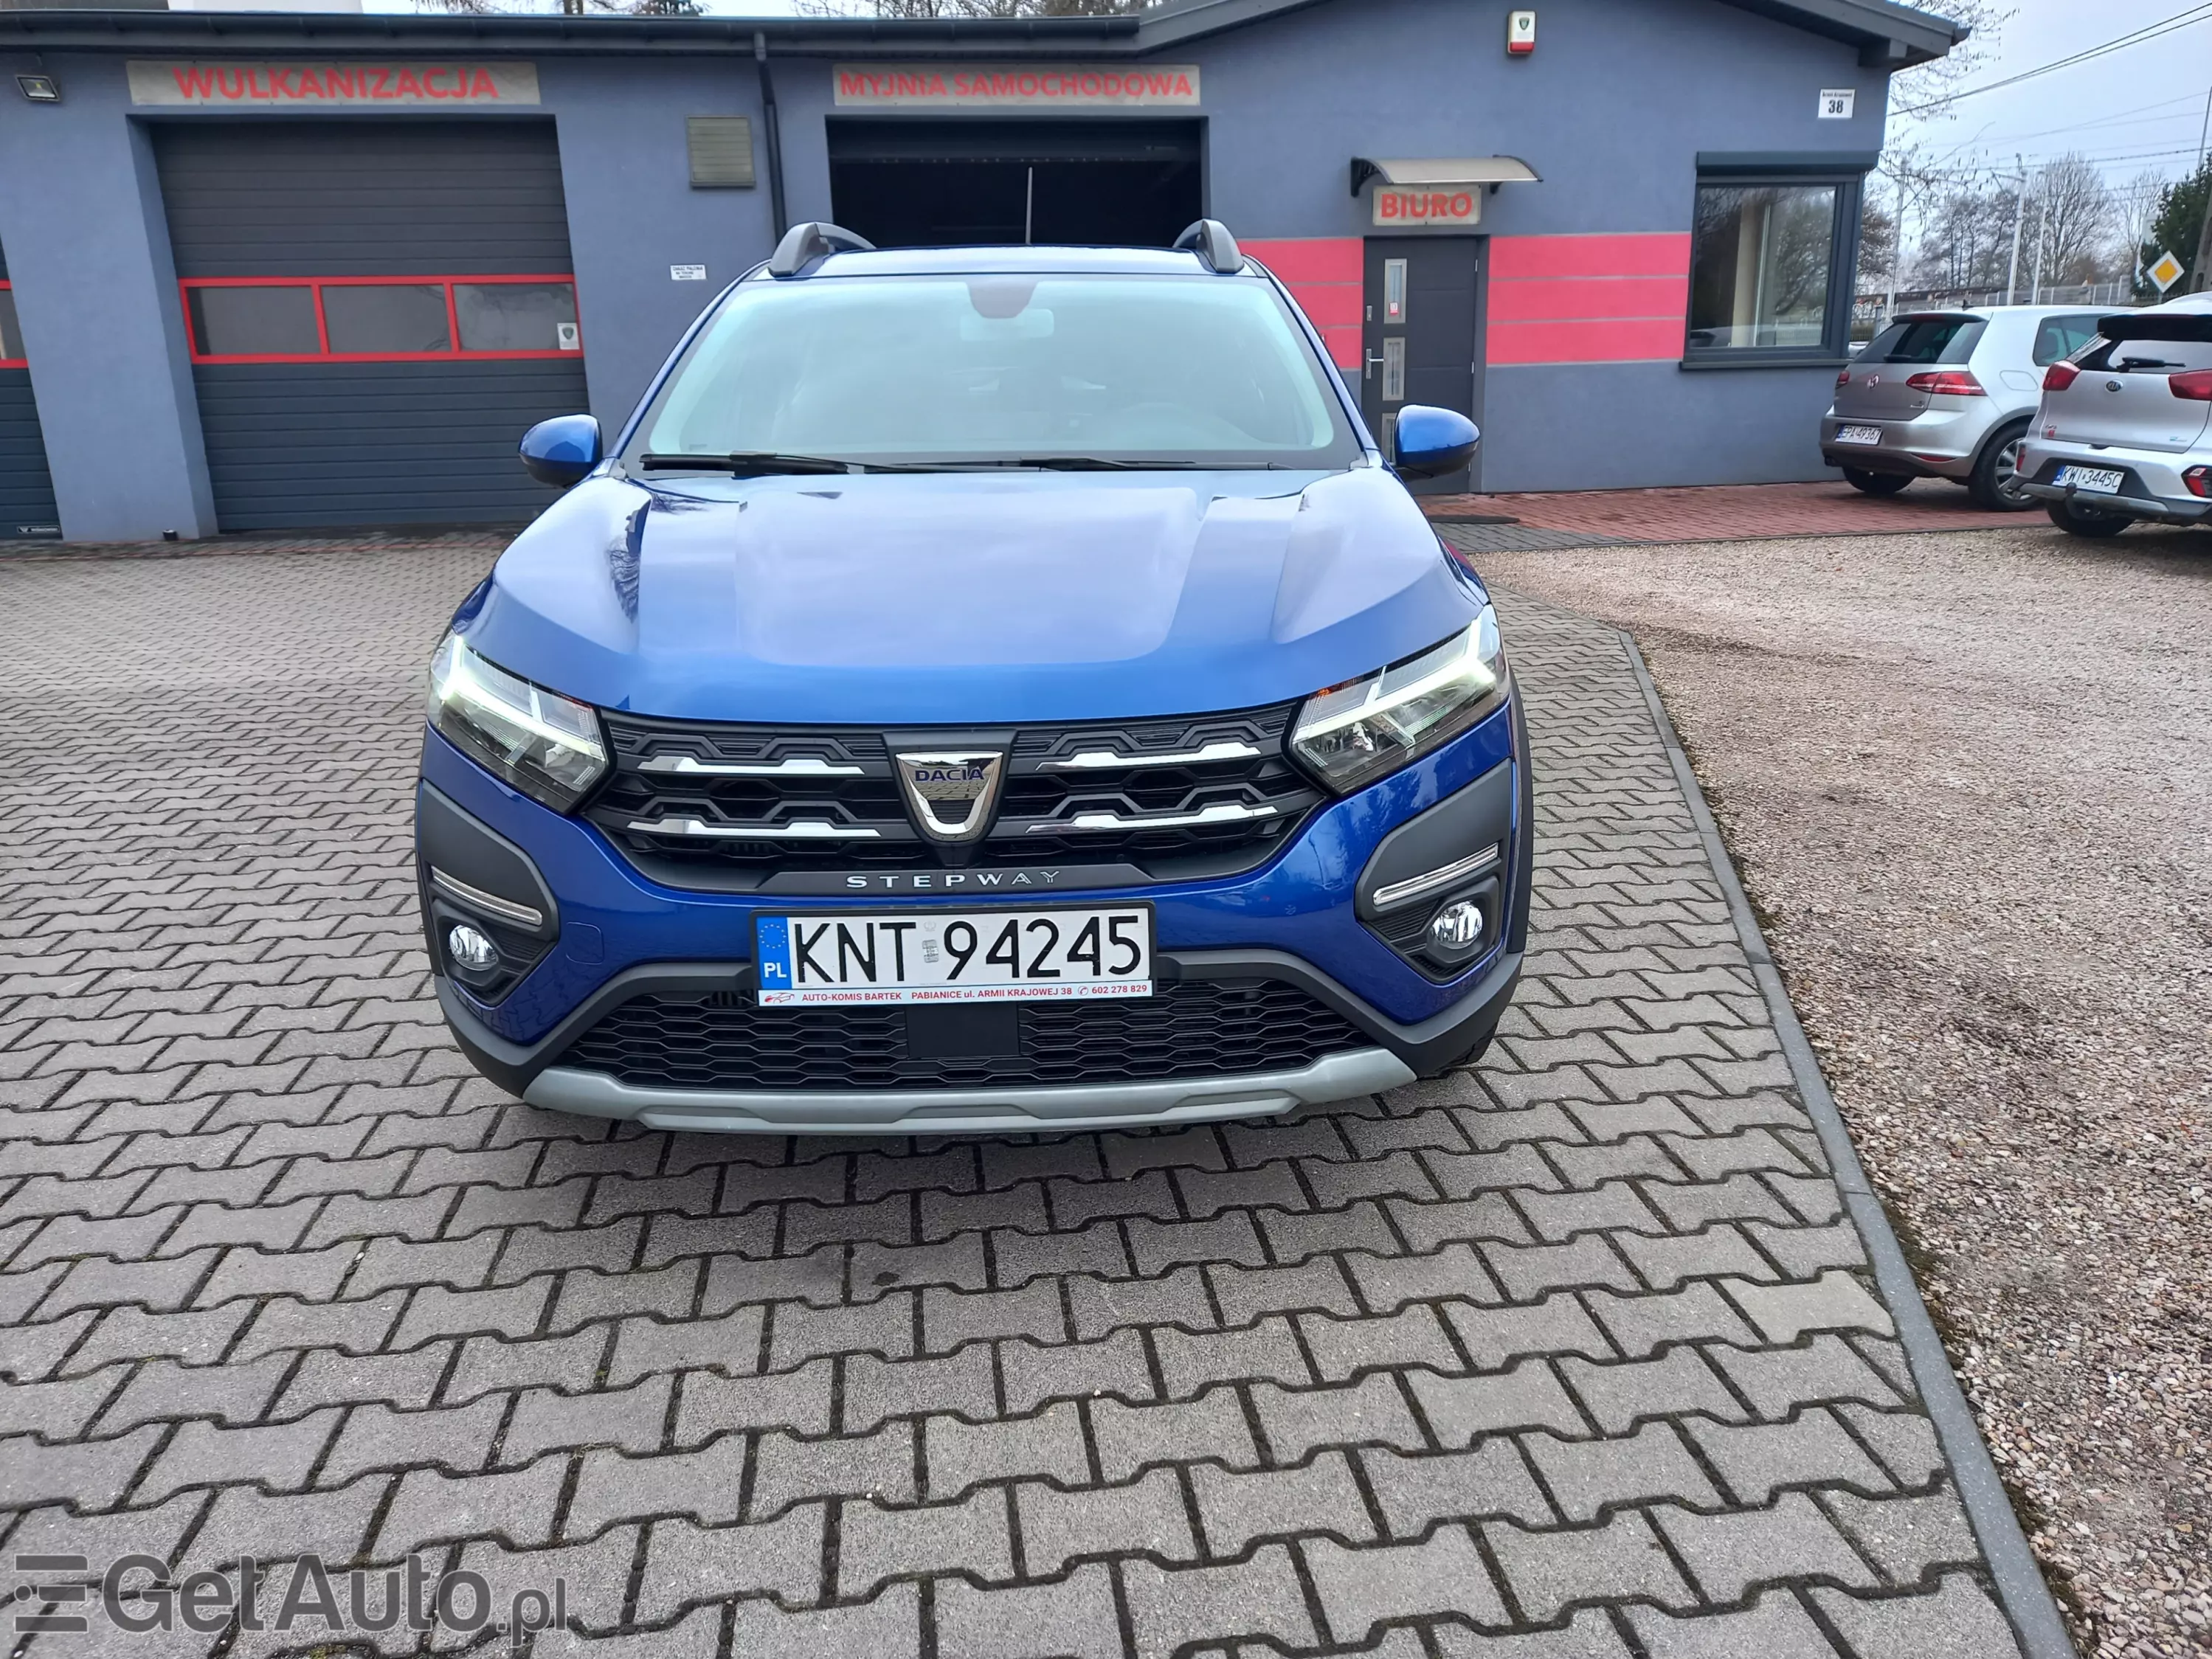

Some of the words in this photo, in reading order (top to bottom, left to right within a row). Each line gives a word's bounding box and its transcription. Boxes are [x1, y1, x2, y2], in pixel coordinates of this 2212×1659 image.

[172, 67, 500, 100] WULKANIZACJA
[839, 72, 947, 97] MYJNIA
[953, 72, 1193, 97] SAMOCHODOWA
[1828, 100, 1844, 114] 38
[1380, 193, 1473, 218] BIURO
[2061, 466, 2083, 482] KWI
[2085, 470, 2122, 488] 3445C
[915, 769, 984, 781] DACIA
[846, 870, 1060, 888] STEPWAY
[794, 921, 916, 983] KNT
[943, 915, 1141, 980] 94245
[764, 962, 787, 978] PL
[802, 993, 863, 1002] AUTO-KOMIS
[865, 992, 902, 1000] BARTEK
[911, 991, 962, 1000] PABIANICE
[964, 989, 975, 998] ul.
[978, 988, 1005, 997] ARMII
[1007, 987, 1058, 997] KRAJOWEJ
[1061, 987, 1072, 995] 38
